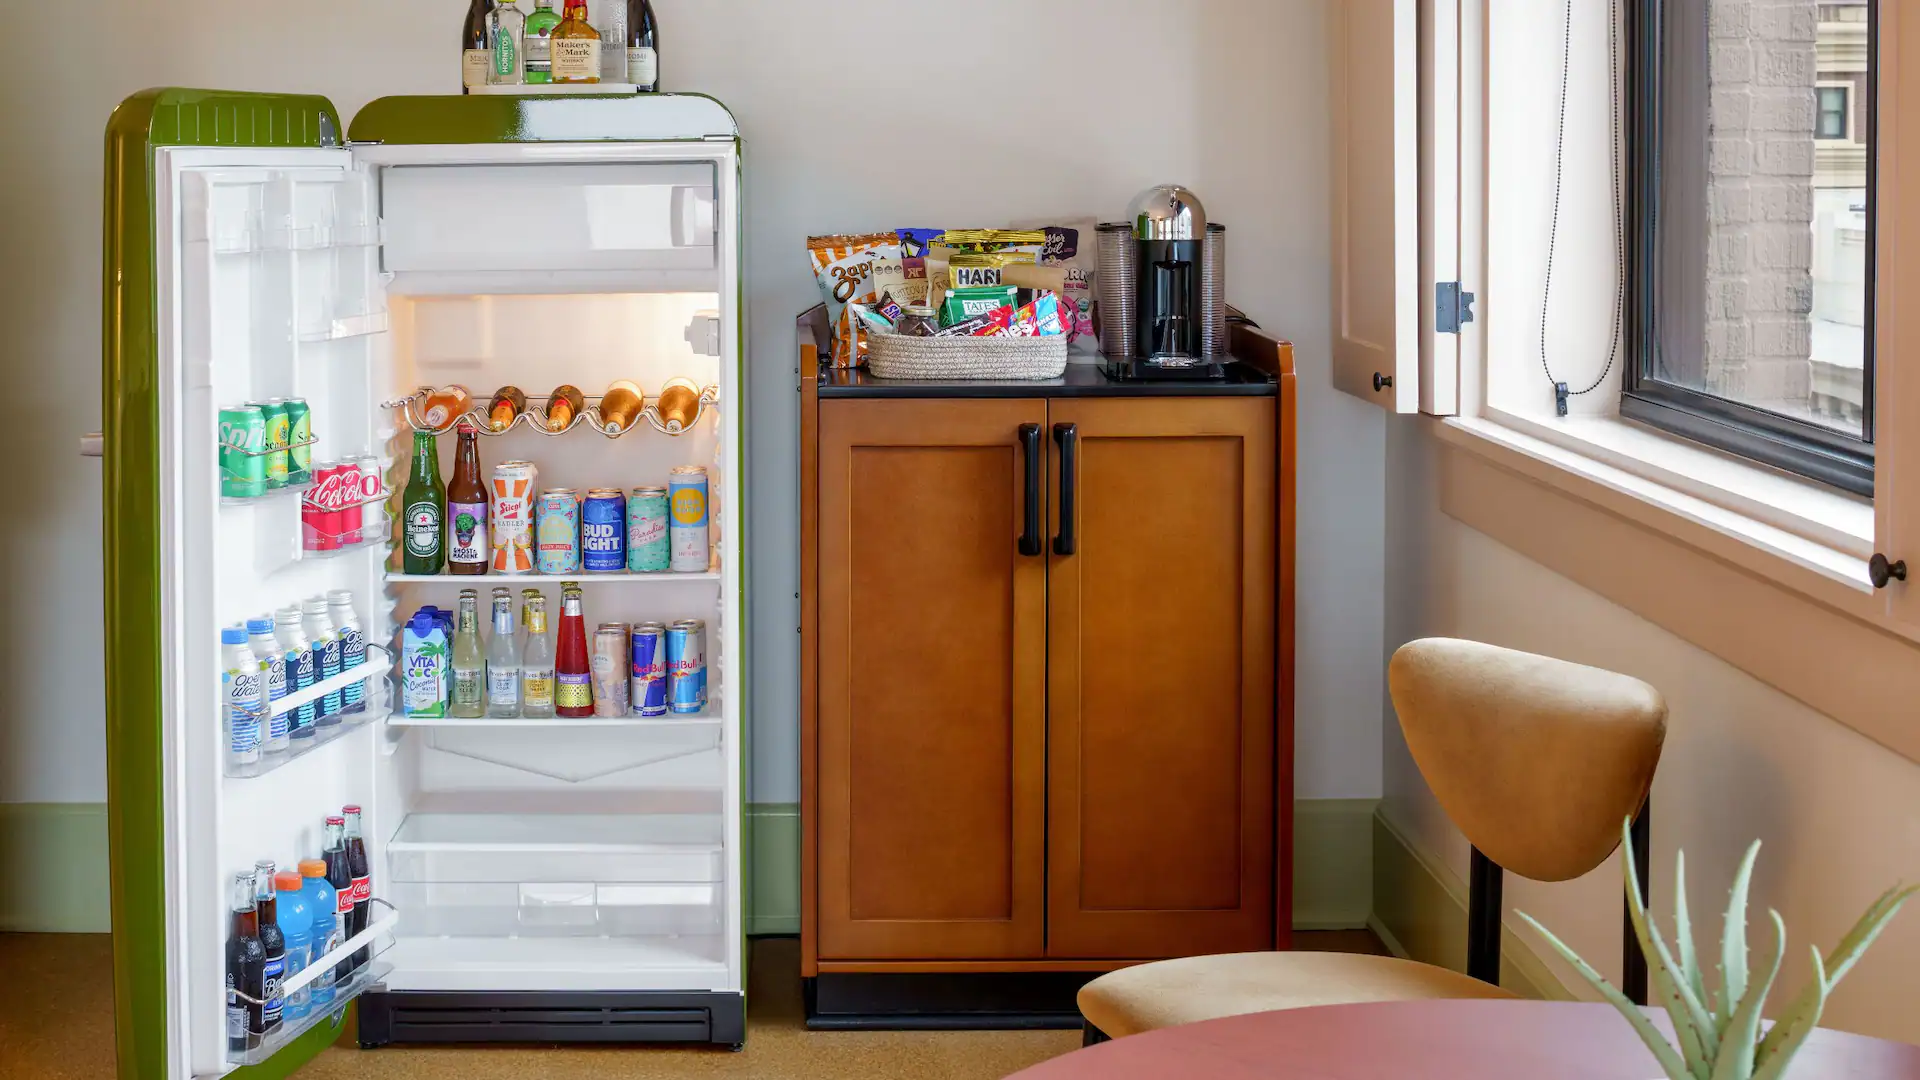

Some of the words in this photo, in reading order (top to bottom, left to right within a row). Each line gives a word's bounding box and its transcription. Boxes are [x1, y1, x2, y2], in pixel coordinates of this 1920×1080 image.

[556, 41, 591, 49] Maker's
[565, 48, 590, 56] Mark
[964, 301, 1000, 311] TATE'S
[407, 524, 440, 533] Heineken
[584, 524, 614, 538] BUD
[409, 655, 436, 668] VITA
[680, 658, 697, 670] Bull
[408, 668, 440, 678] COCO
[634, 664, 650, 673] Red
[651, 663, 665, 673] Bull
